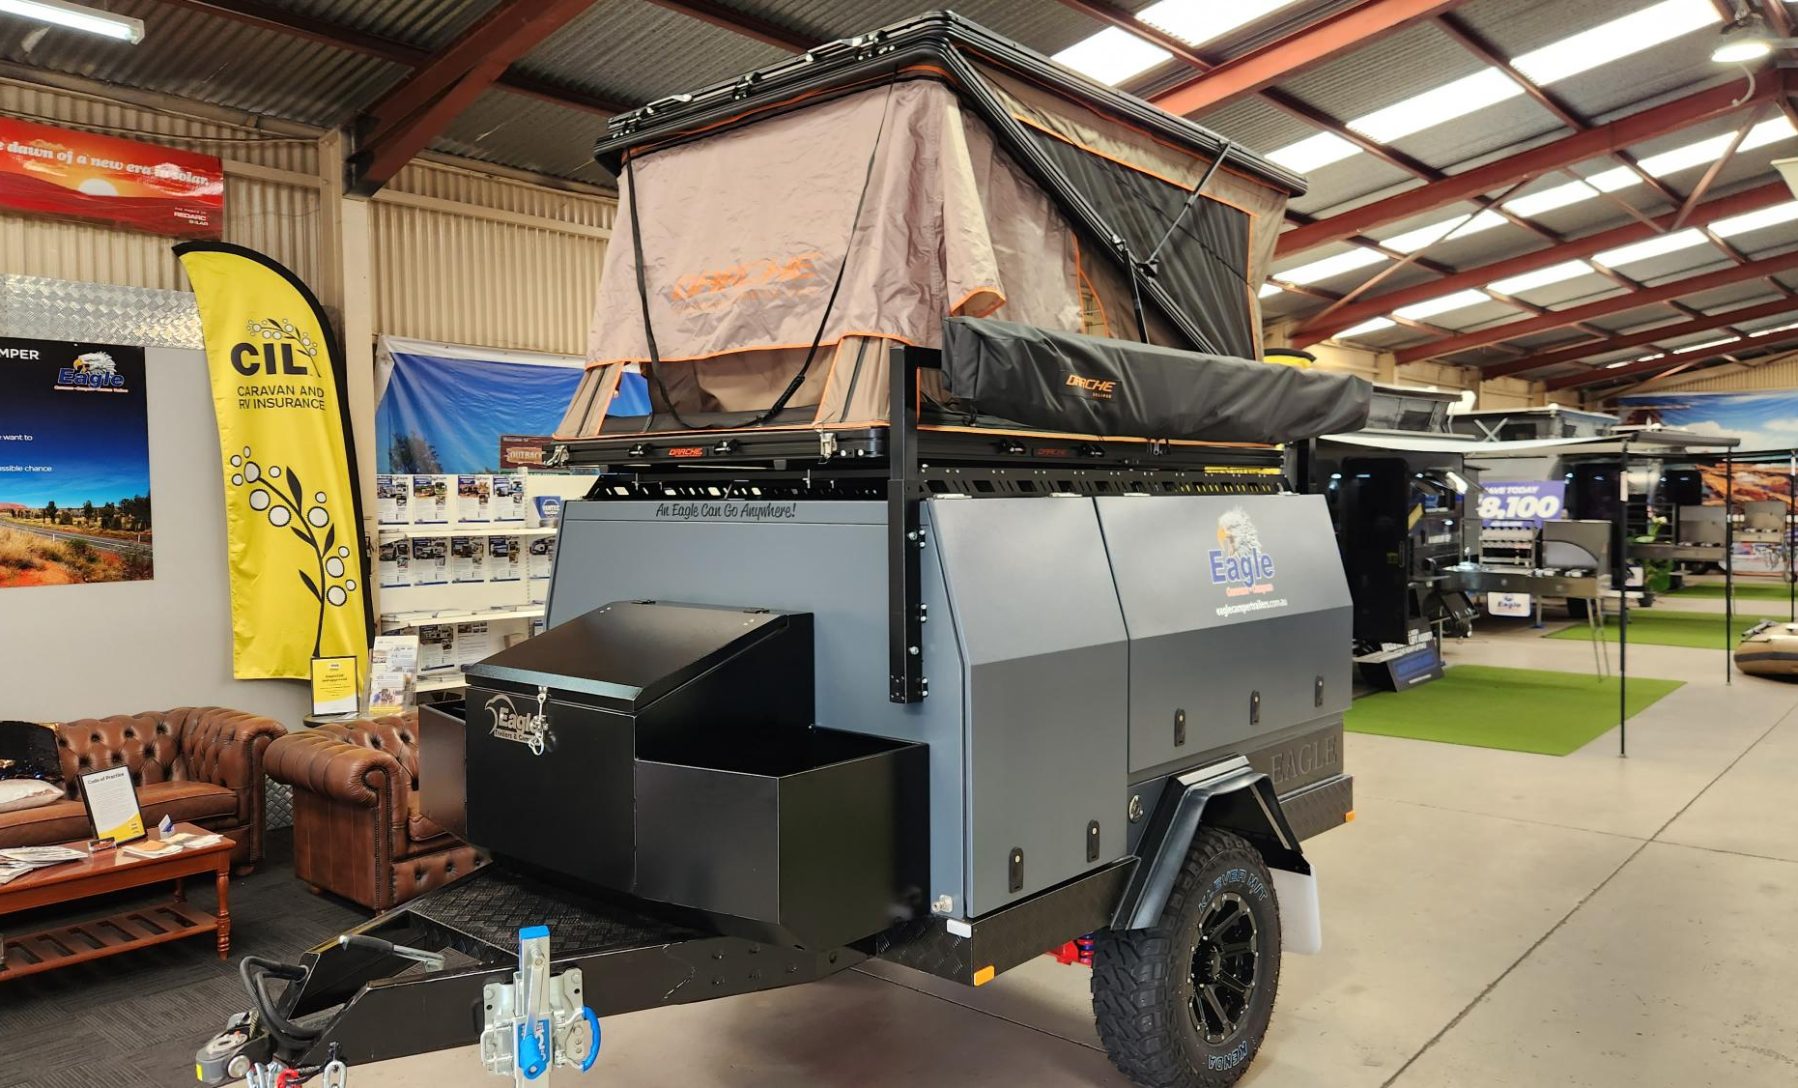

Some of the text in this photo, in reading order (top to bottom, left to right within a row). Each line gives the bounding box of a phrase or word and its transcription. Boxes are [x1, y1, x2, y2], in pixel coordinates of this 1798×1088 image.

[7, 141, 54, 159] dawn
[57, 150, 73, 165] of
[77, 155, 88, 165] a
[91, 158, 123, 171] new
[126, 163, 152, 176] era
[230, 342, 308, 377] CIL
[57, 367, 125, 388] Eagle
[1065, 374, 1117, 393] DARCHE
[237, 385, 325, 398] CARAVAN AND
[239, 397, 325, 411] RV INSURANCE
[3, 434, 33, 442] want to
[668, 447, 703, 457] DARCHE
[1507, 485, 1539, 495] TODAY
[655, 503, 797, 520] An Eagle Can Go Anywhere!
[1208, 547, 1275, 588] Eagle
[498, 707, 542, 736] Eagle
[1271, 735, 1338, 785] EAGLE
[105, 772, 125, 780] Practice
[1208, 1040, 1248, 1071] KENDA
